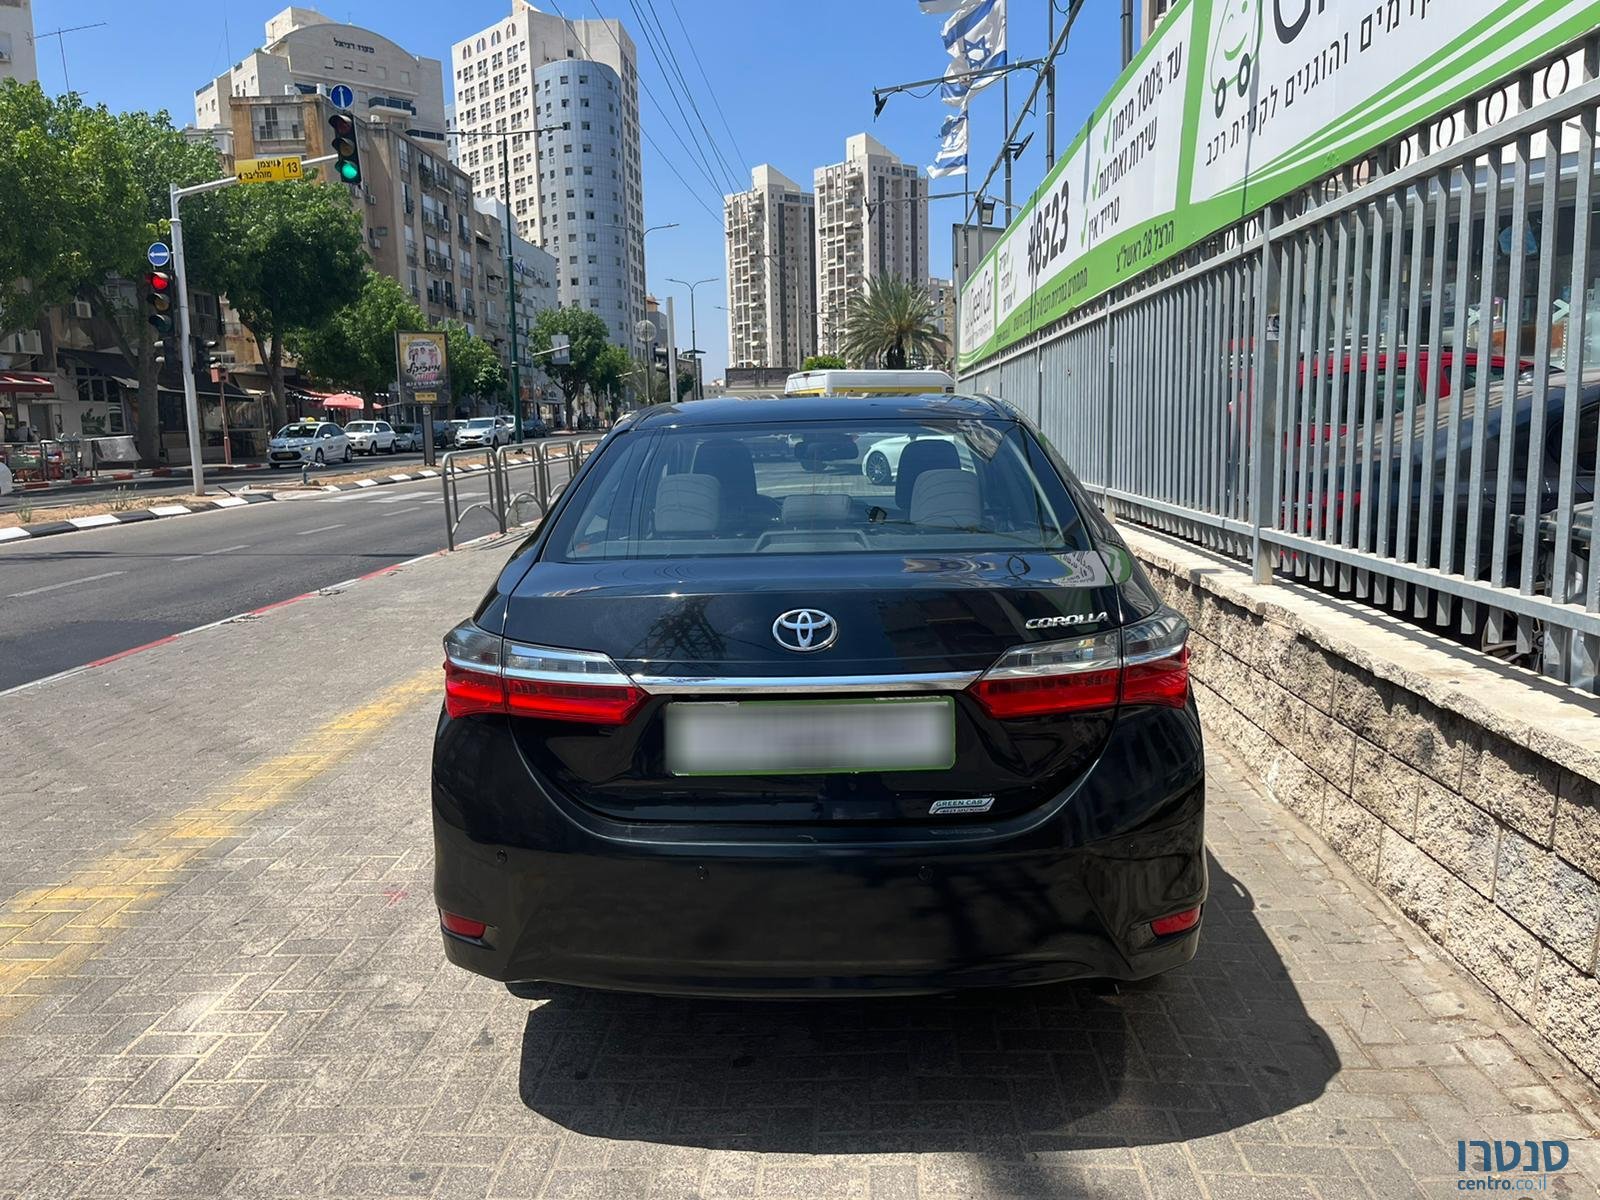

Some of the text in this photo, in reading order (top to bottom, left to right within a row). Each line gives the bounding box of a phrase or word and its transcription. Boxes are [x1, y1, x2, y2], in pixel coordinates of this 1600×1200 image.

[333, 36, 355, 49] דניאל
[1285, 32, 1349, 108] והוגנים
[1112, 41, 1183, 154] עד 100% מימון
[1231, 84, 1278, 143] לקניית
[1098, 116, 1158, 200] שירות ואמינות
[1206, 129, 1226, 167] רכב
[243, 169, 272, 180] מוהליבר
[257, 159, 276, 171] ויצמן
[286, 161, 298, 174] 13
[1088, 195, 1120, 253] טרייד אין
[1153, 219, 1174, 252] הרצל
[1143, 228, 1152, 257] 28
[1025, 611, 1109, 630] COROLLA
